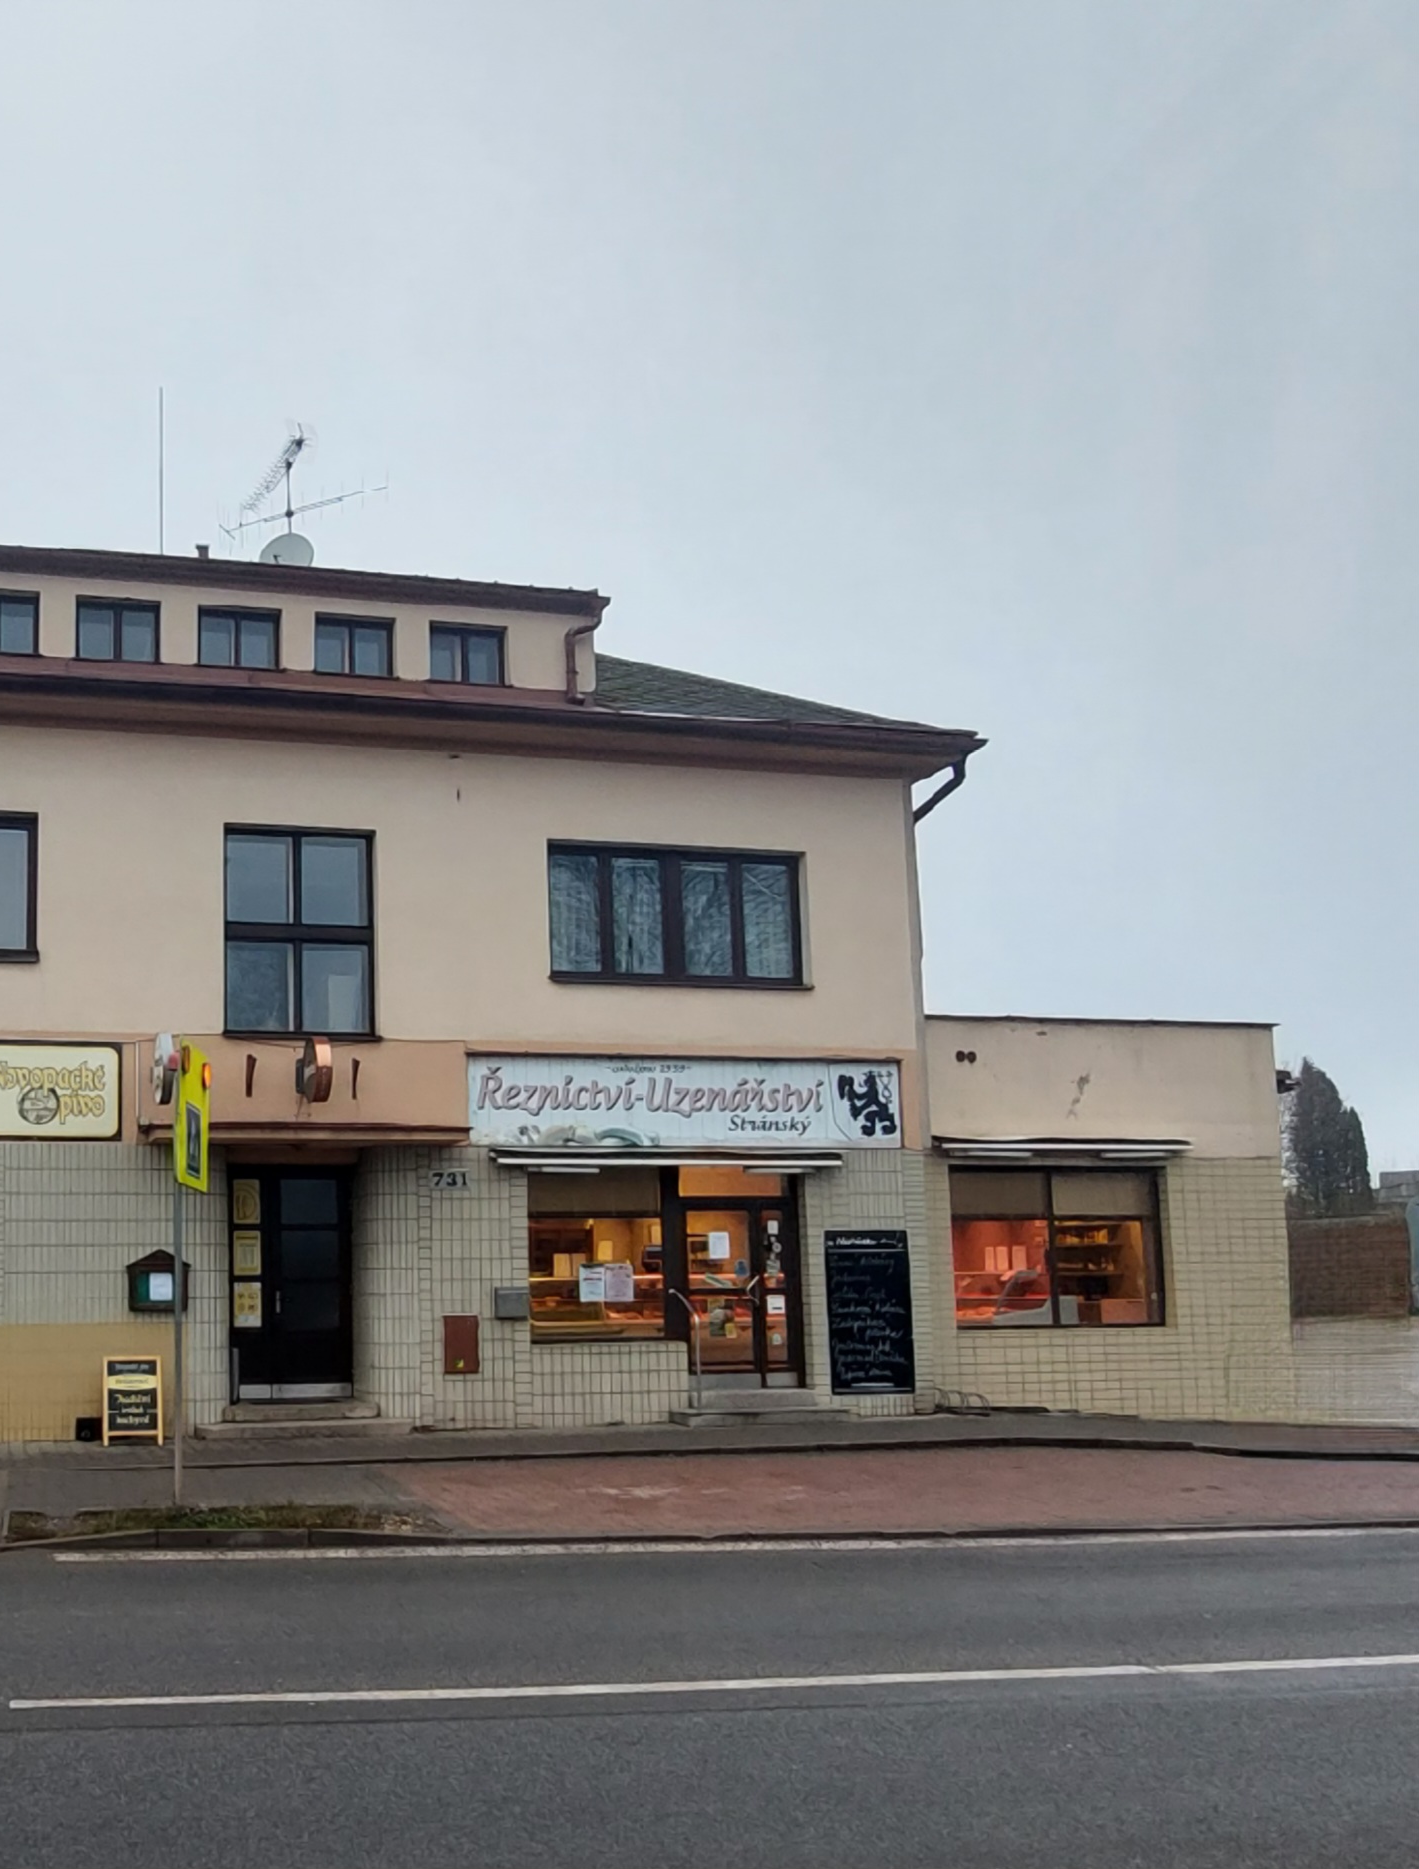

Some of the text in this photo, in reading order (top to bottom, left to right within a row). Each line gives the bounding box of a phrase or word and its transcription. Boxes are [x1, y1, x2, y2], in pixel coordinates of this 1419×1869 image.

[58, 1091, 106, 1125] pivo
[728, 1114, 812, 1137] Stránský
[432, 1171, 469, 1188] 731
